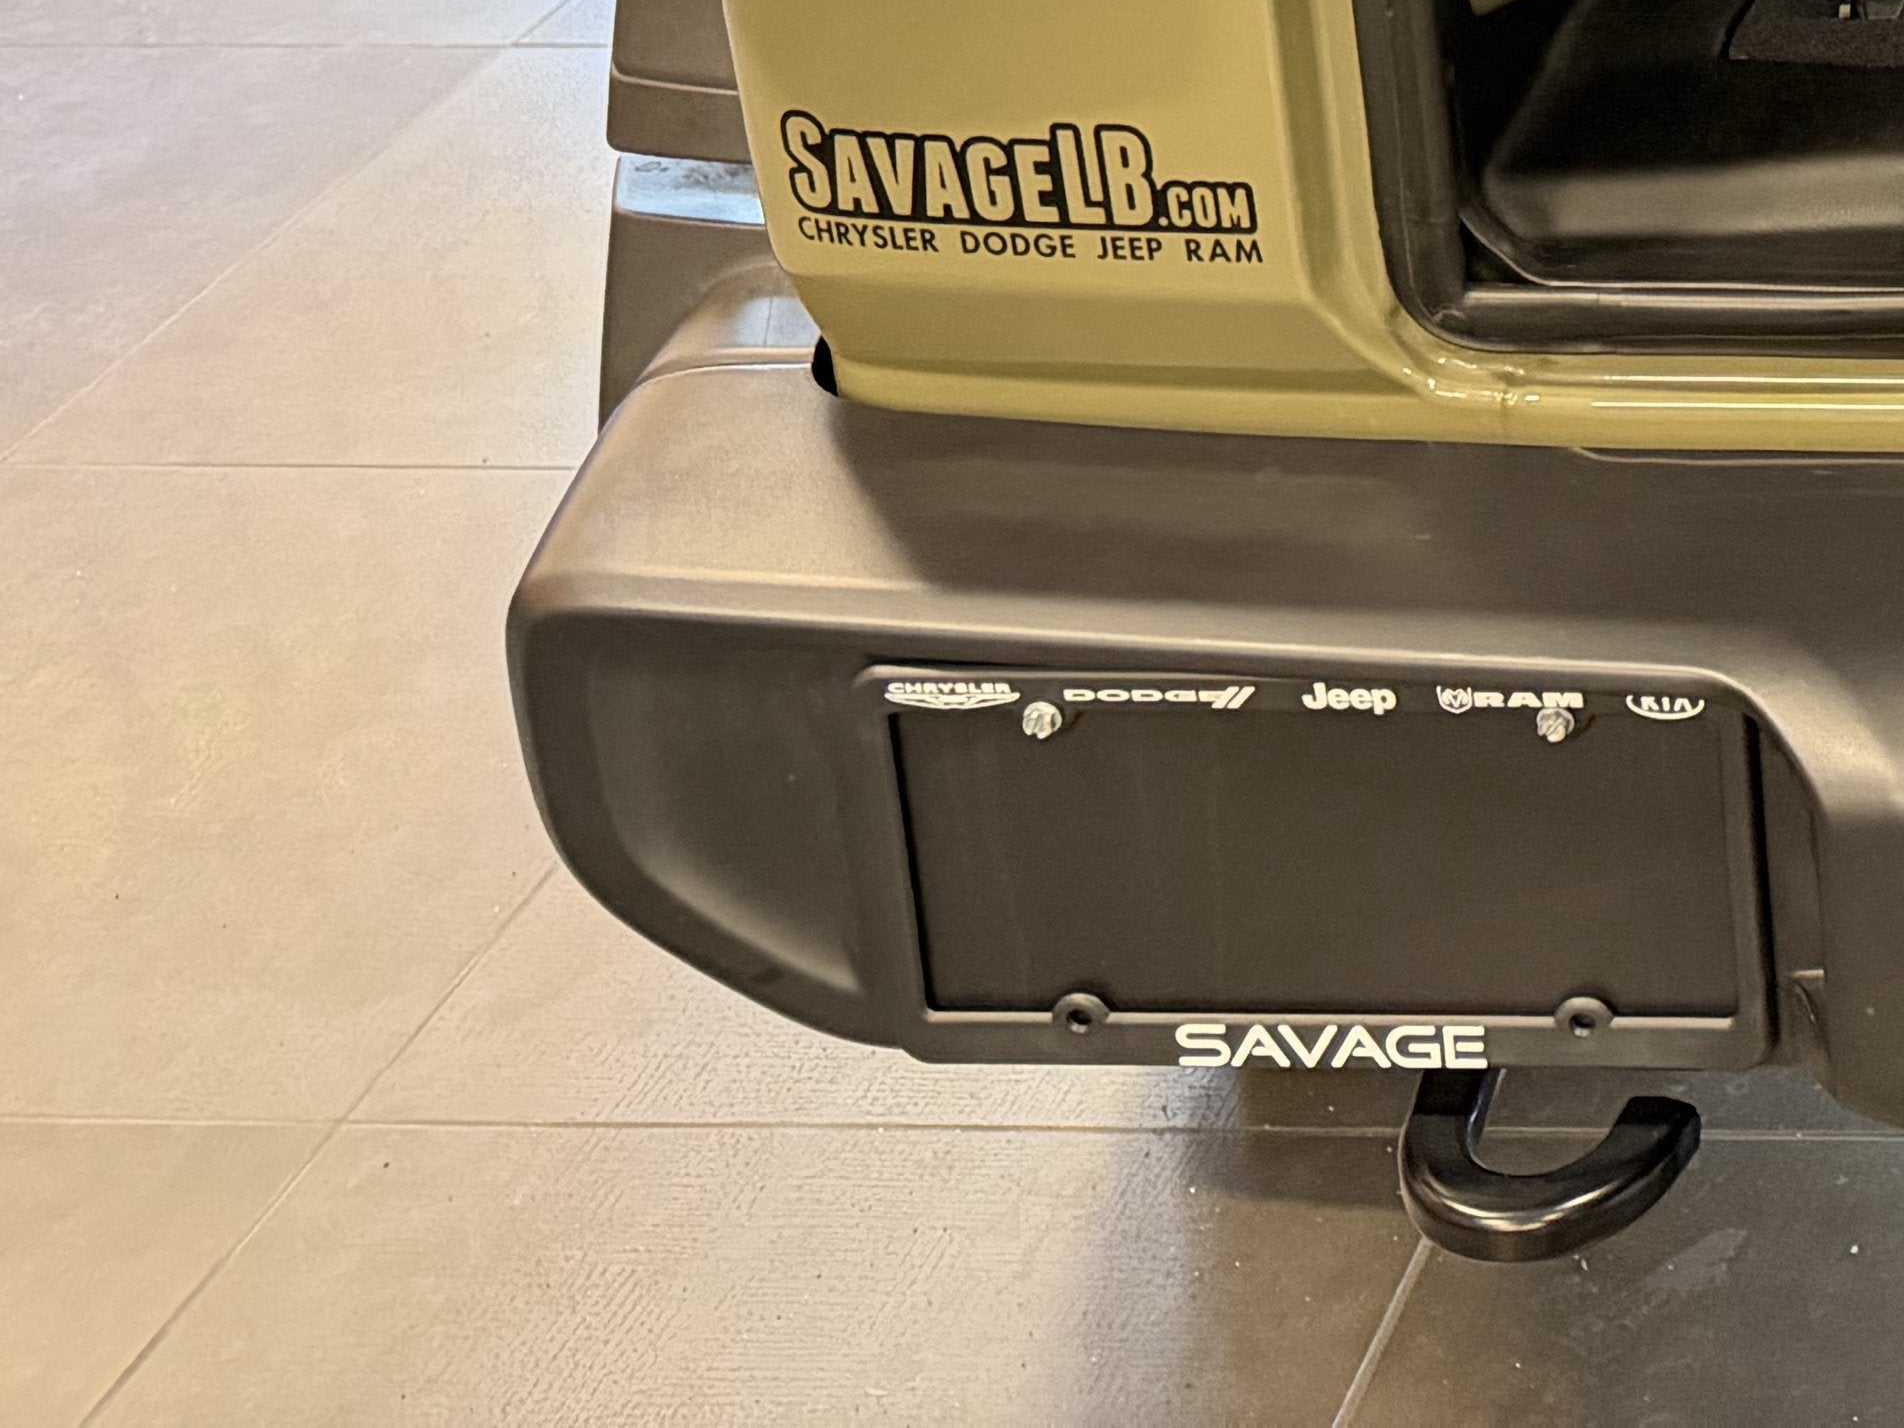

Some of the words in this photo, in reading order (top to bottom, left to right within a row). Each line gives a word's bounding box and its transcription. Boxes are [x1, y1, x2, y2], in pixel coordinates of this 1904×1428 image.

[799, 217, 939, 252] CHRYSLER
[962, 231, 1076, 258] DODGE
[1097, 236, 1163, 261] JEEP
[1186, 240, 1263, 263] RAM
[887, 682, 1011, 694] CHRYSLER
[1063, 688, 1227, 702] DODGE
[1302, 682, 1397, 715] Jeep
[1473, 691, 1584, 708] RAM
[1640, 695, 1694, 712] KIA
[1175, 1024, 1488, 1069] SAVAGE
